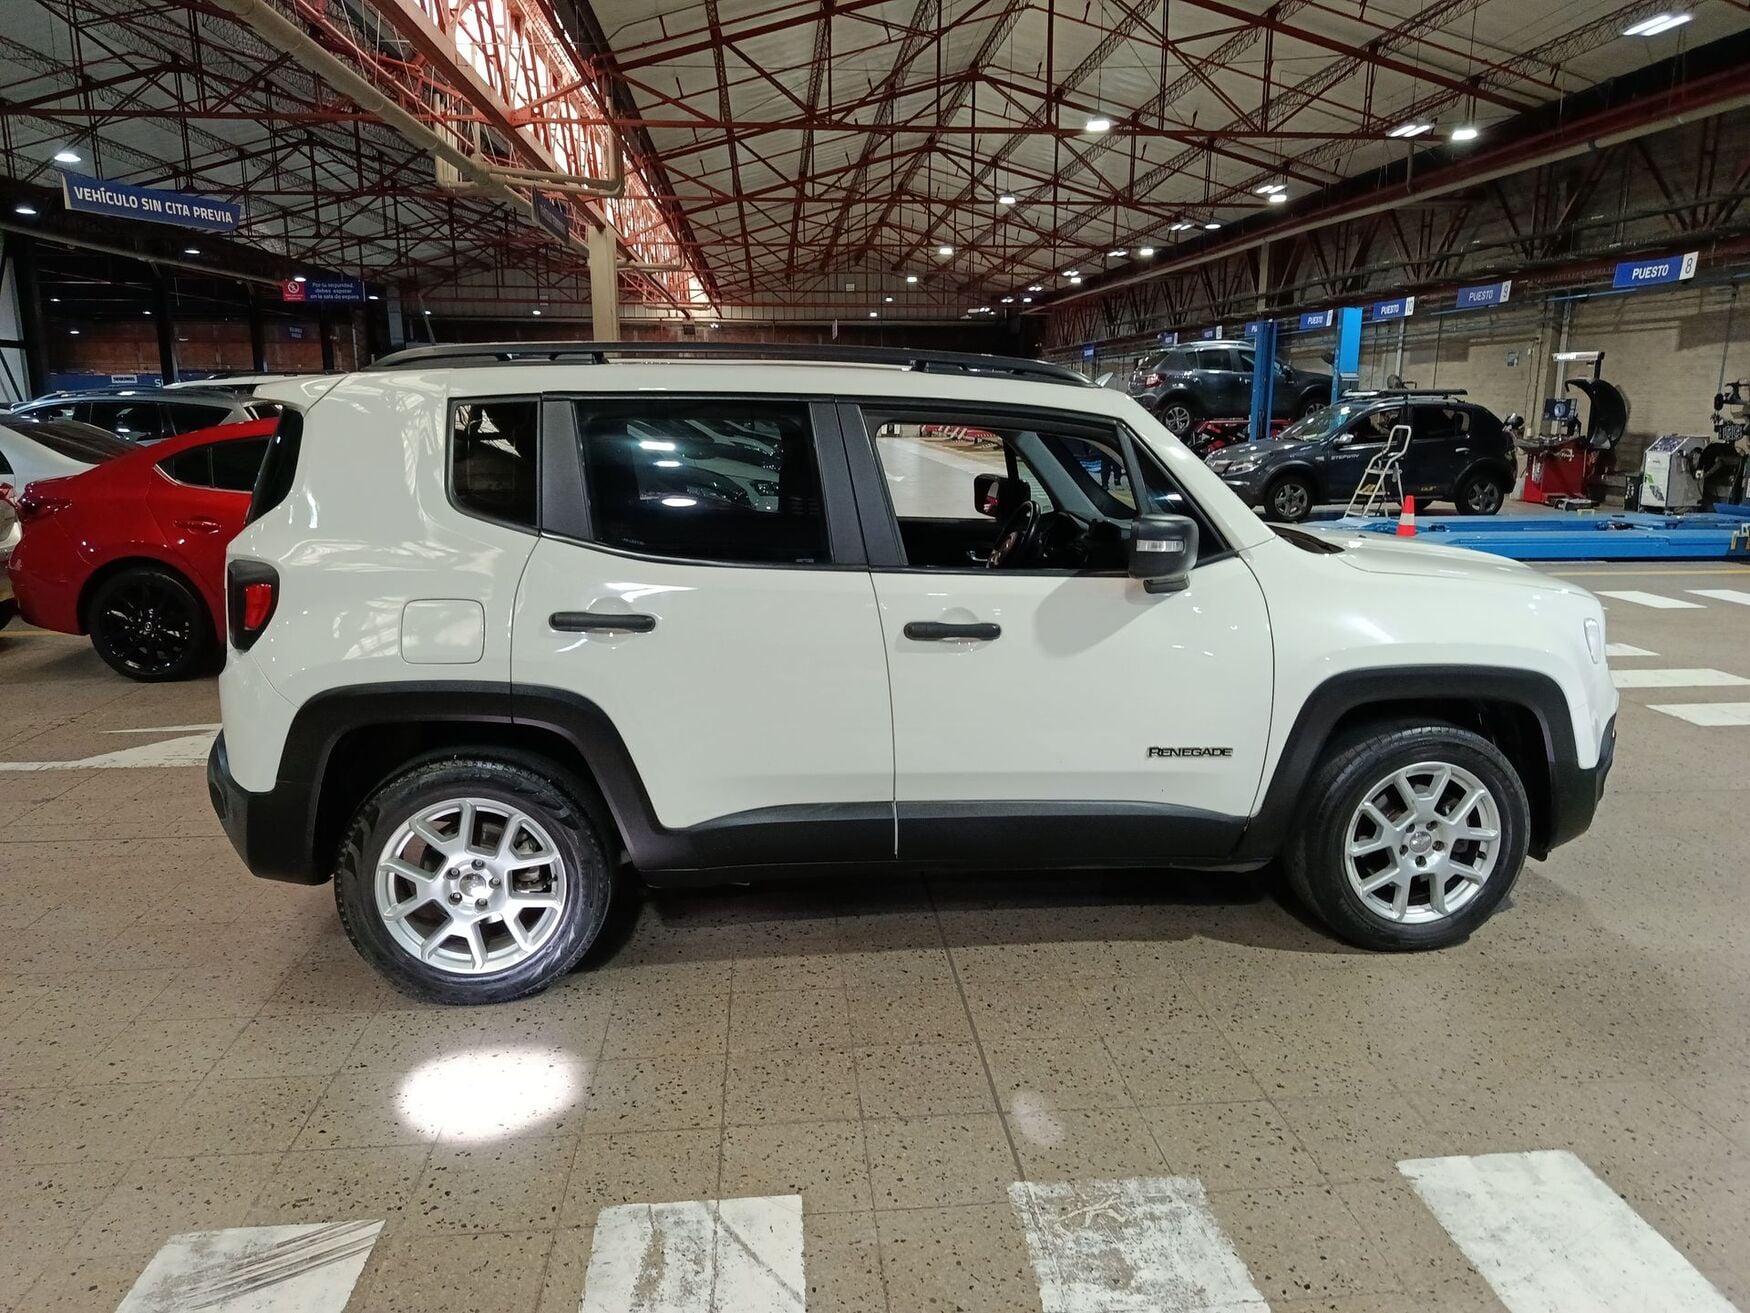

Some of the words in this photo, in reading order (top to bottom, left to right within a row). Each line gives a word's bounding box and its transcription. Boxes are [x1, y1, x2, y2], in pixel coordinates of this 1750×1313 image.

[73, 185, 138, 209] VEHÍCULO
[141, 199, 162, 213] SIN
[165, 202, 191, 217] CITA
[193, 206, 233, 224] PREVIA
[1632, 264, 1669, 280] PUESTO
[1685, 257, 1693, 274] 8
[1468, 290, 1494, 302] PUESTO
[1503, 285, 1509, 298] 9
[1380, 303, 1400, 315] PUESTO
[1406, 300, 1413, 313] 10
